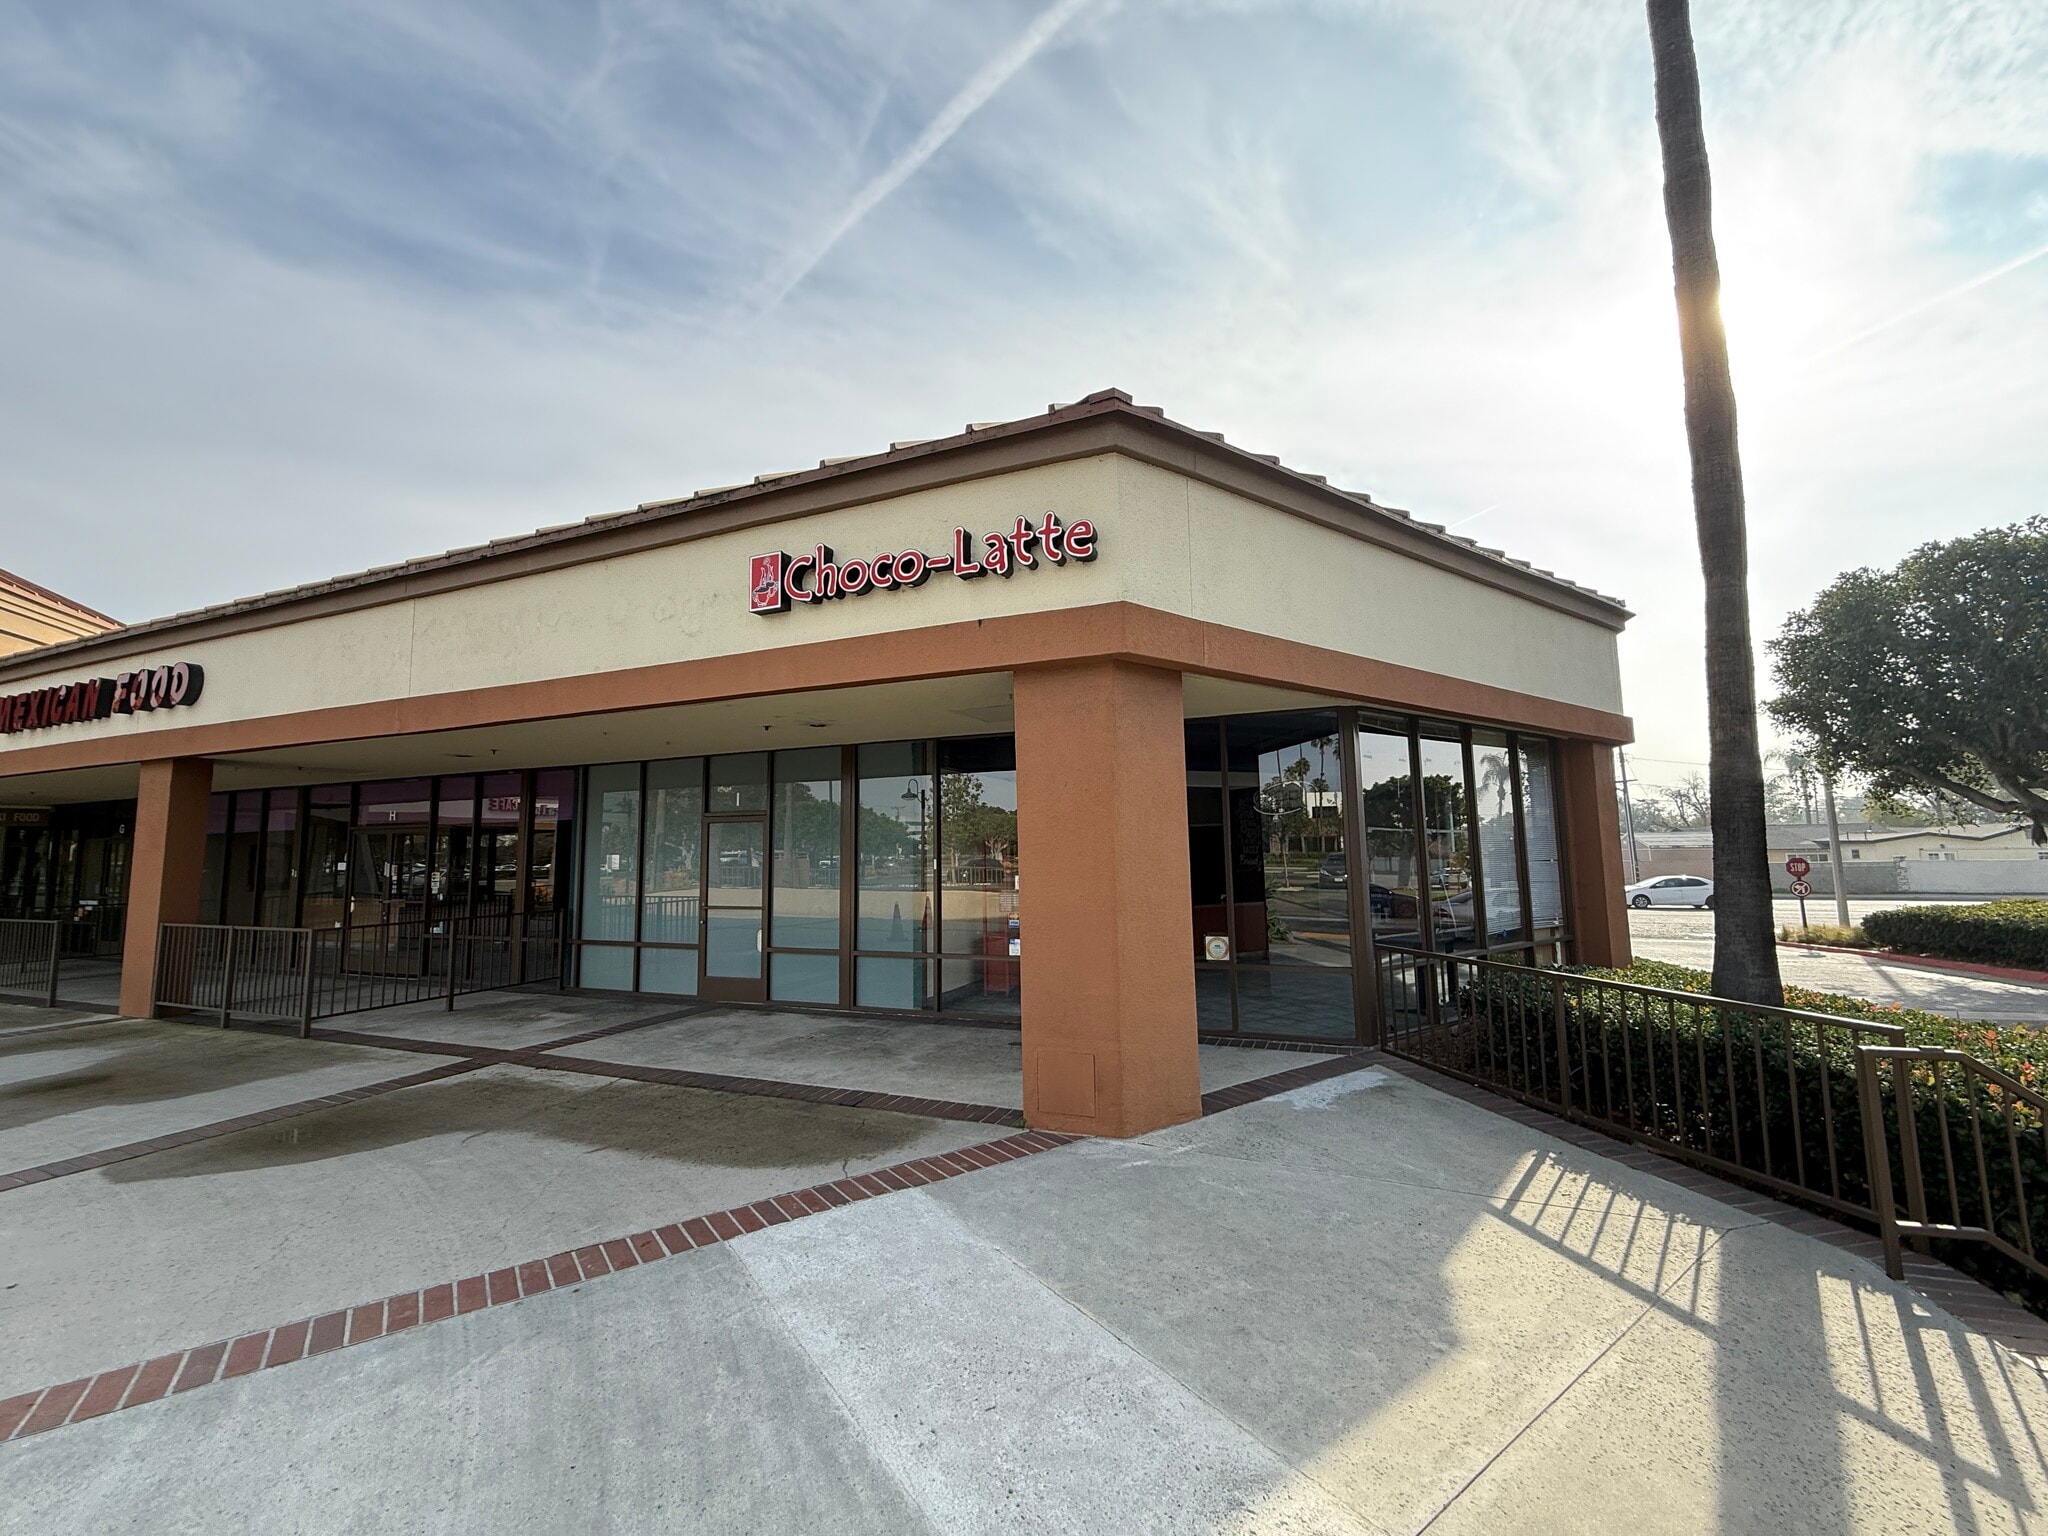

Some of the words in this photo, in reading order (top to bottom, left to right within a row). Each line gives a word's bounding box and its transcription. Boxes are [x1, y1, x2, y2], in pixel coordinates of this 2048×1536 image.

[784, 511, 1094, 602] Choco-Latte
[112, 662, 191, 713] FOOD
[14, 812, 40, 822] FOOD
[389, 810, 396, 821] H
[119, 824, 126, 834] G
[1790, 862, 1806, 872] STOP
